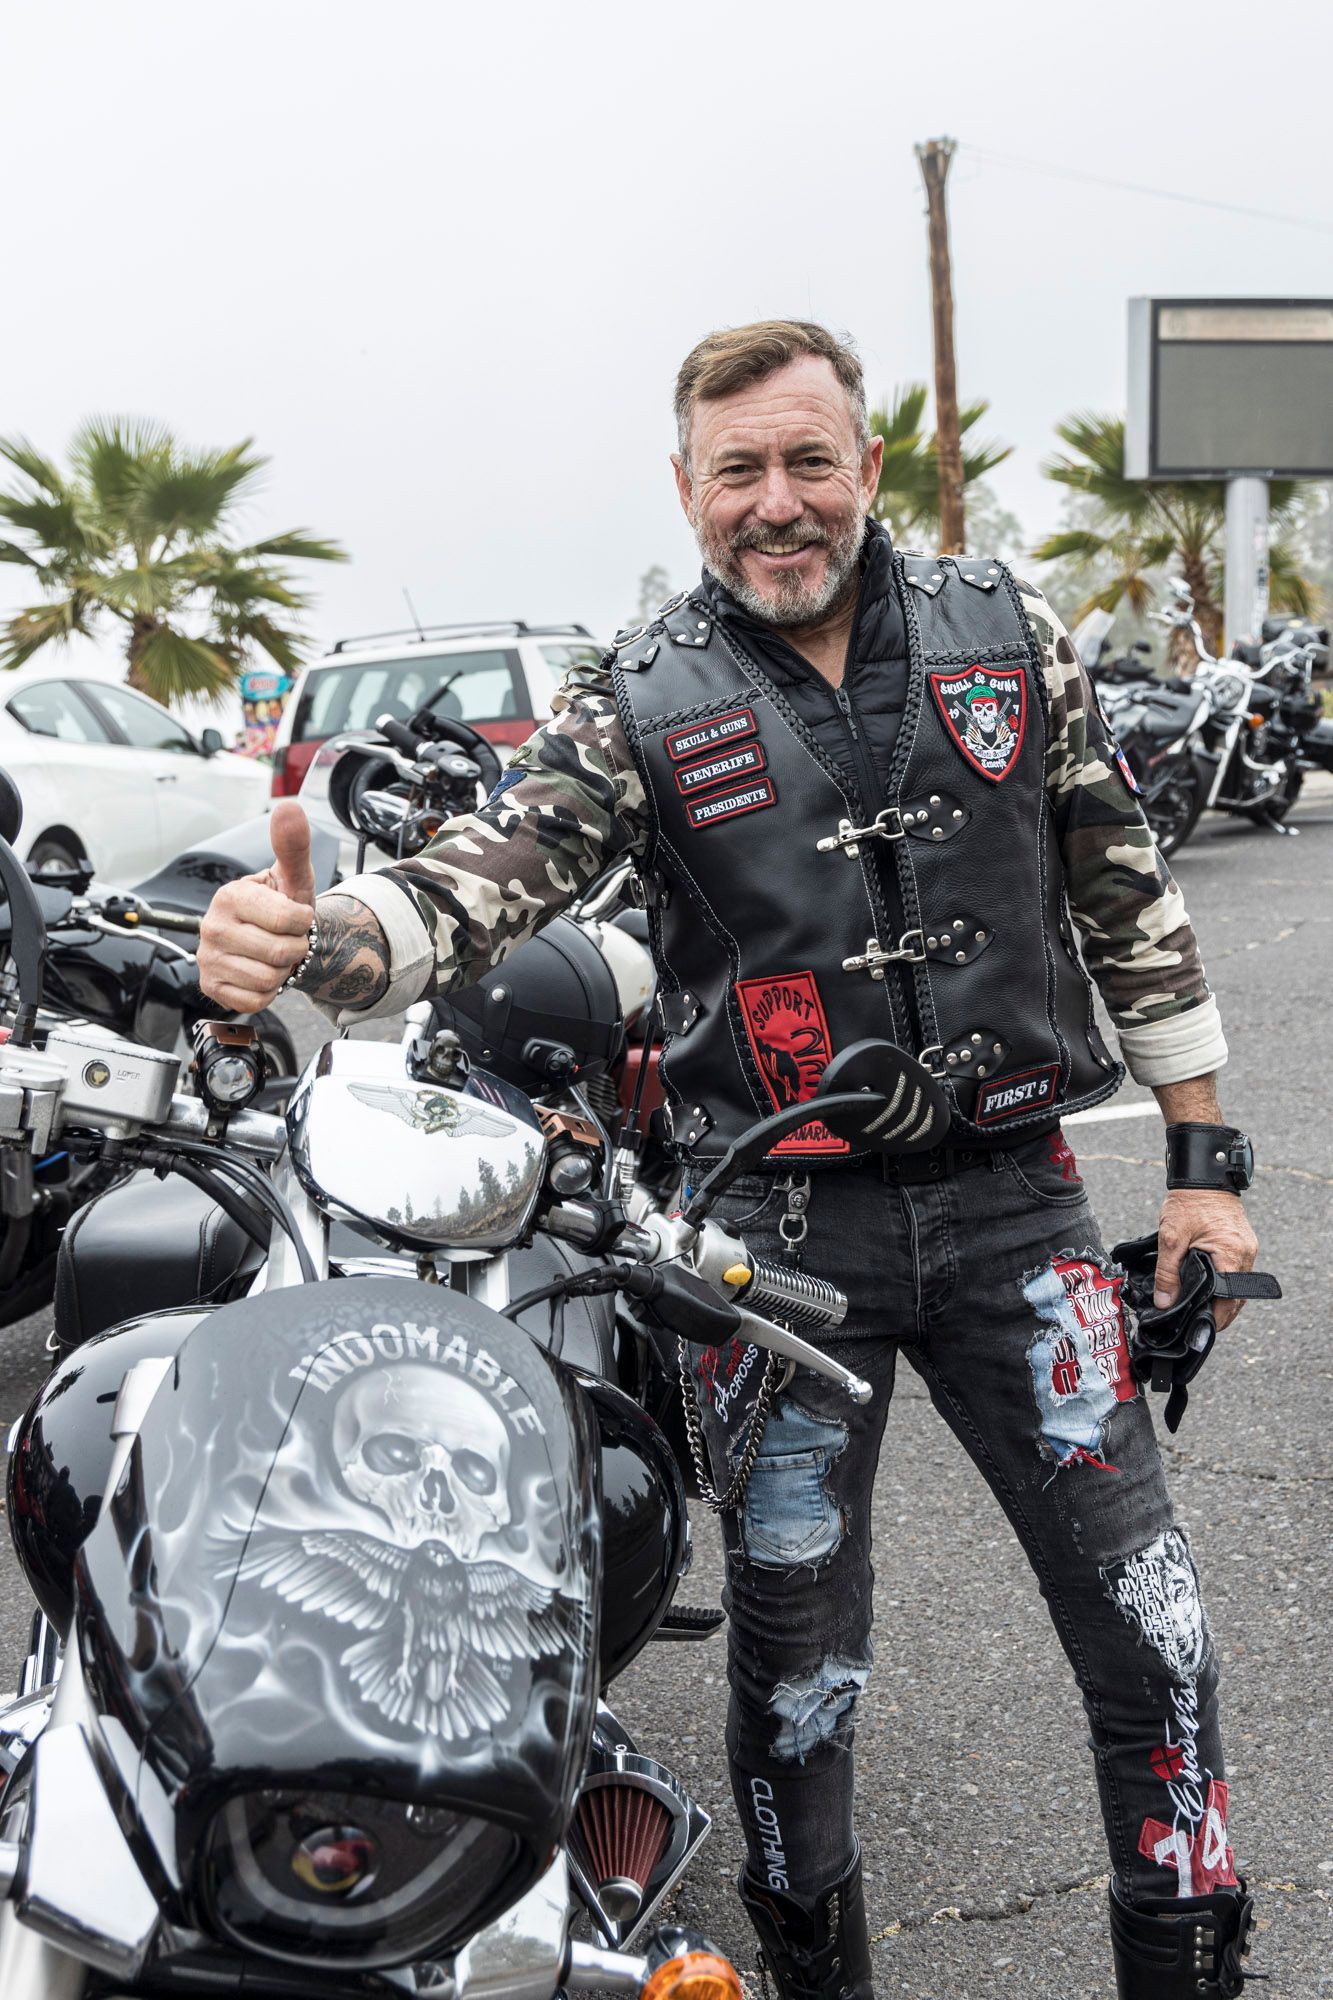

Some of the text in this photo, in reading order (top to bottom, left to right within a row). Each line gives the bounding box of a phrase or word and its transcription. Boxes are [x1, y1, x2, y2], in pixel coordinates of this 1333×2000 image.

[940, 671, 1019, 695] SKULL & GUNS
[675, 717, 748, 752] SKULL & GUNS
[682, 752, 755, 785] TENERIFE
[694, 788, 768, 821] PRESIDENTE
[752, 985, 815, 1031] SUPPORT
[984, 1079, 1049, 1113] FIRST 5
[1078, 1287, 1119, 1325] YOUR
[288, 1322, 546, 1436] INDOMABLE
[730, 1343, 758, 1398] CROSS
[1118, 1574, 1161, 1593] OVER
[1124, 1560, 1160, 1578] NOT
[1117, 1588, 1165, 1606] WHEN
[1134, 1601, 1169, 1618] YOU
[750, 1777, 790, 1890] CLOTHING
